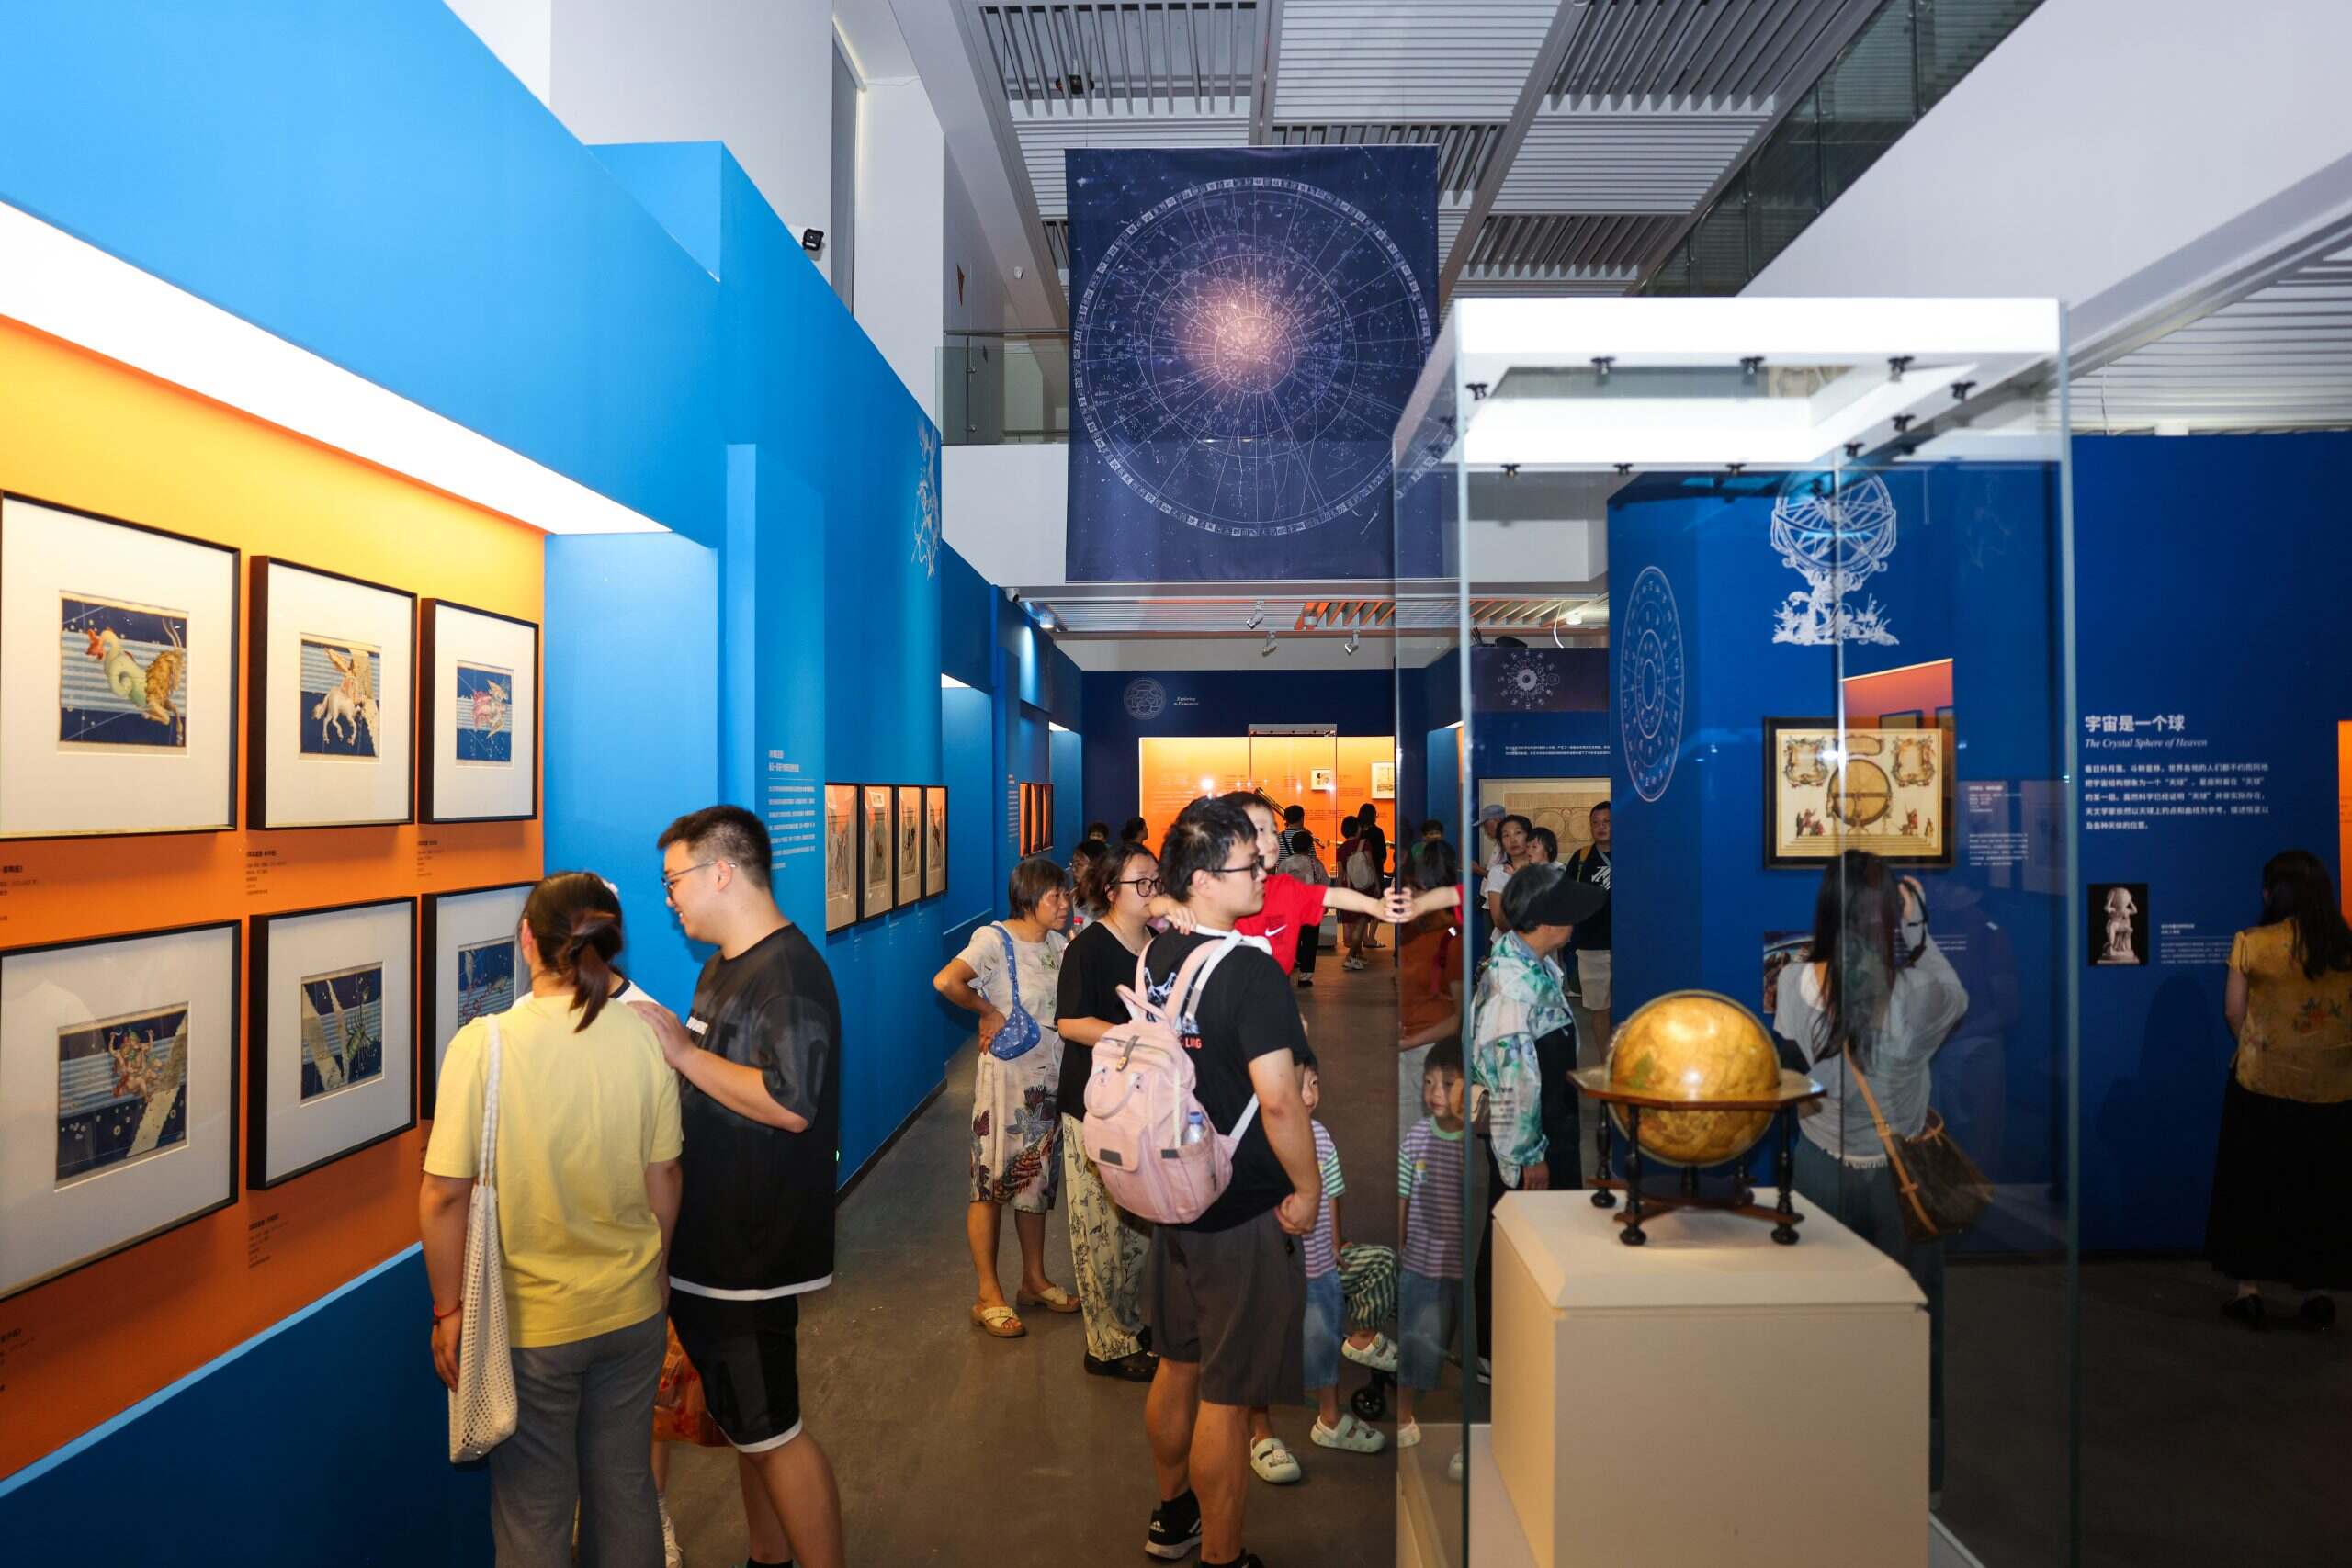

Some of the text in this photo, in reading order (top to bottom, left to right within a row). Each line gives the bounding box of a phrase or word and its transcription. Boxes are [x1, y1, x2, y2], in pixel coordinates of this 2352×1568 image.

[2085, 714, 2186, 733] 宇宙是一个球
[2085, 738, 2208, 750] The Crystal Sphere of Heaven
